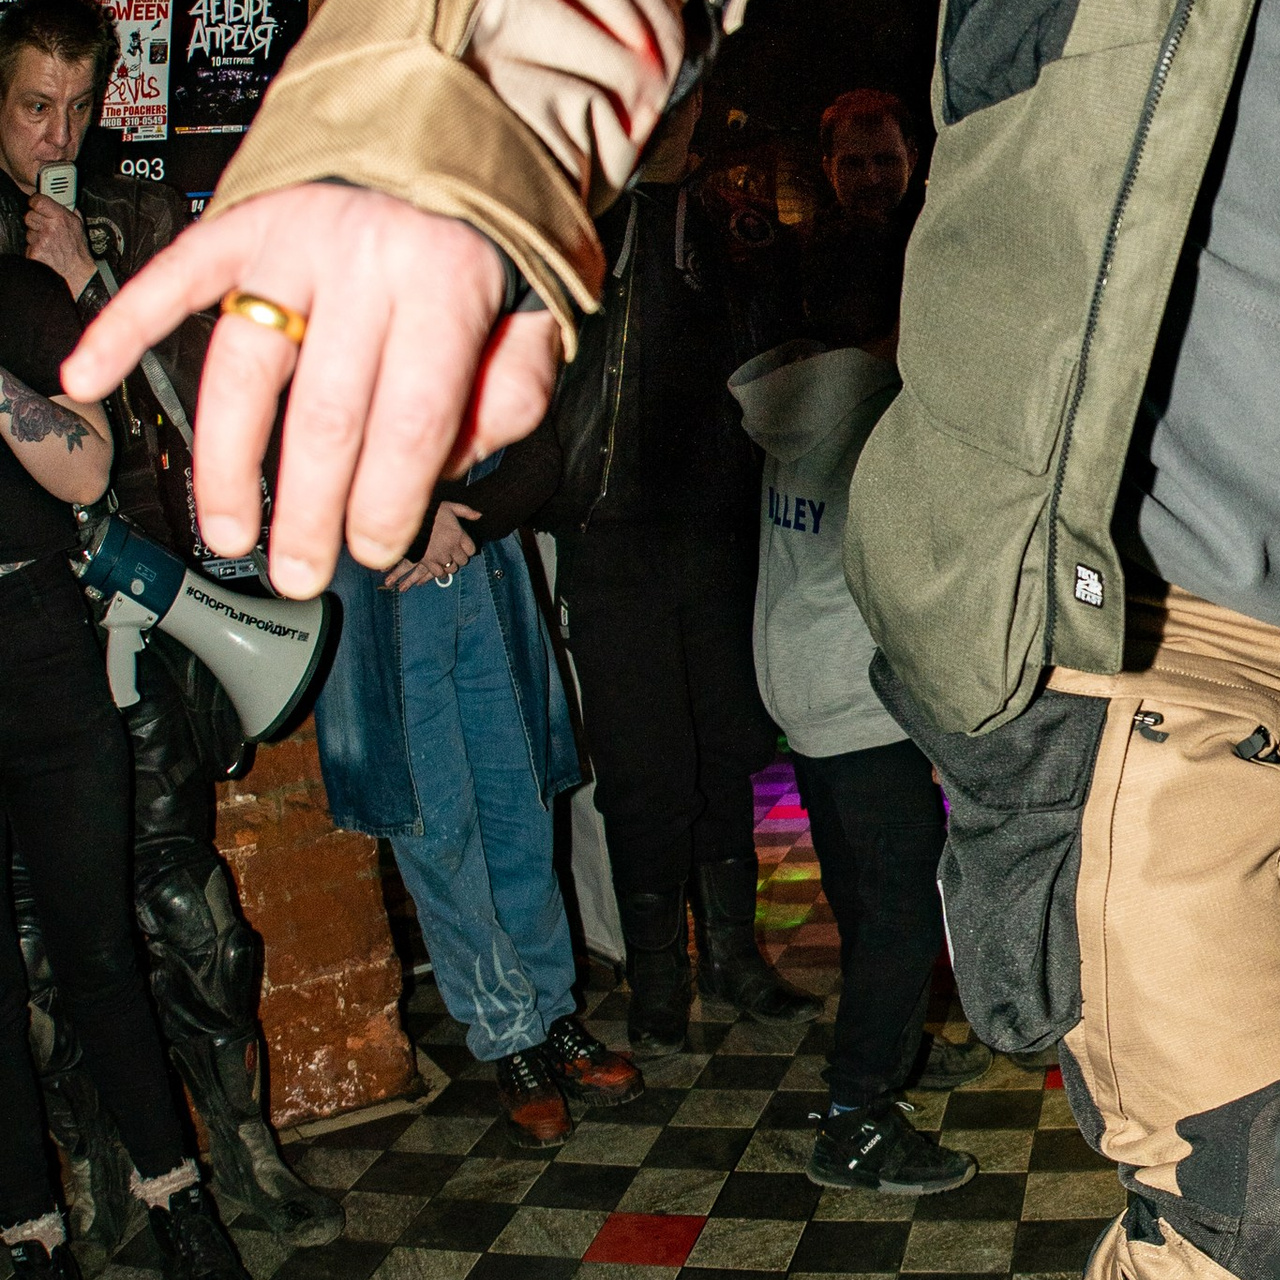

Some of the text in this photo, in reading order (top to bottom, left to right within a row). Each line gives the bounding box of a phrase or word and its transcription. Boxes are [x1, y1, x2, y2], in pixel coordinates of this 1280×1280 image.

[104, 0, 169, 21] OWEEN
[186, 18, 279, 63] АПРЕЛЯ
[211, 57, 221, 67] 10
[233, 57, 255, 65] ГРУППЕ
[106, 104, 167, 117] The POACHERS
[125, 116, 163, 126] 310-0549
[121, 158, 164, 180] 993
[186, 586, 299, 640] #СПОРТЫПРОЙДУТ
